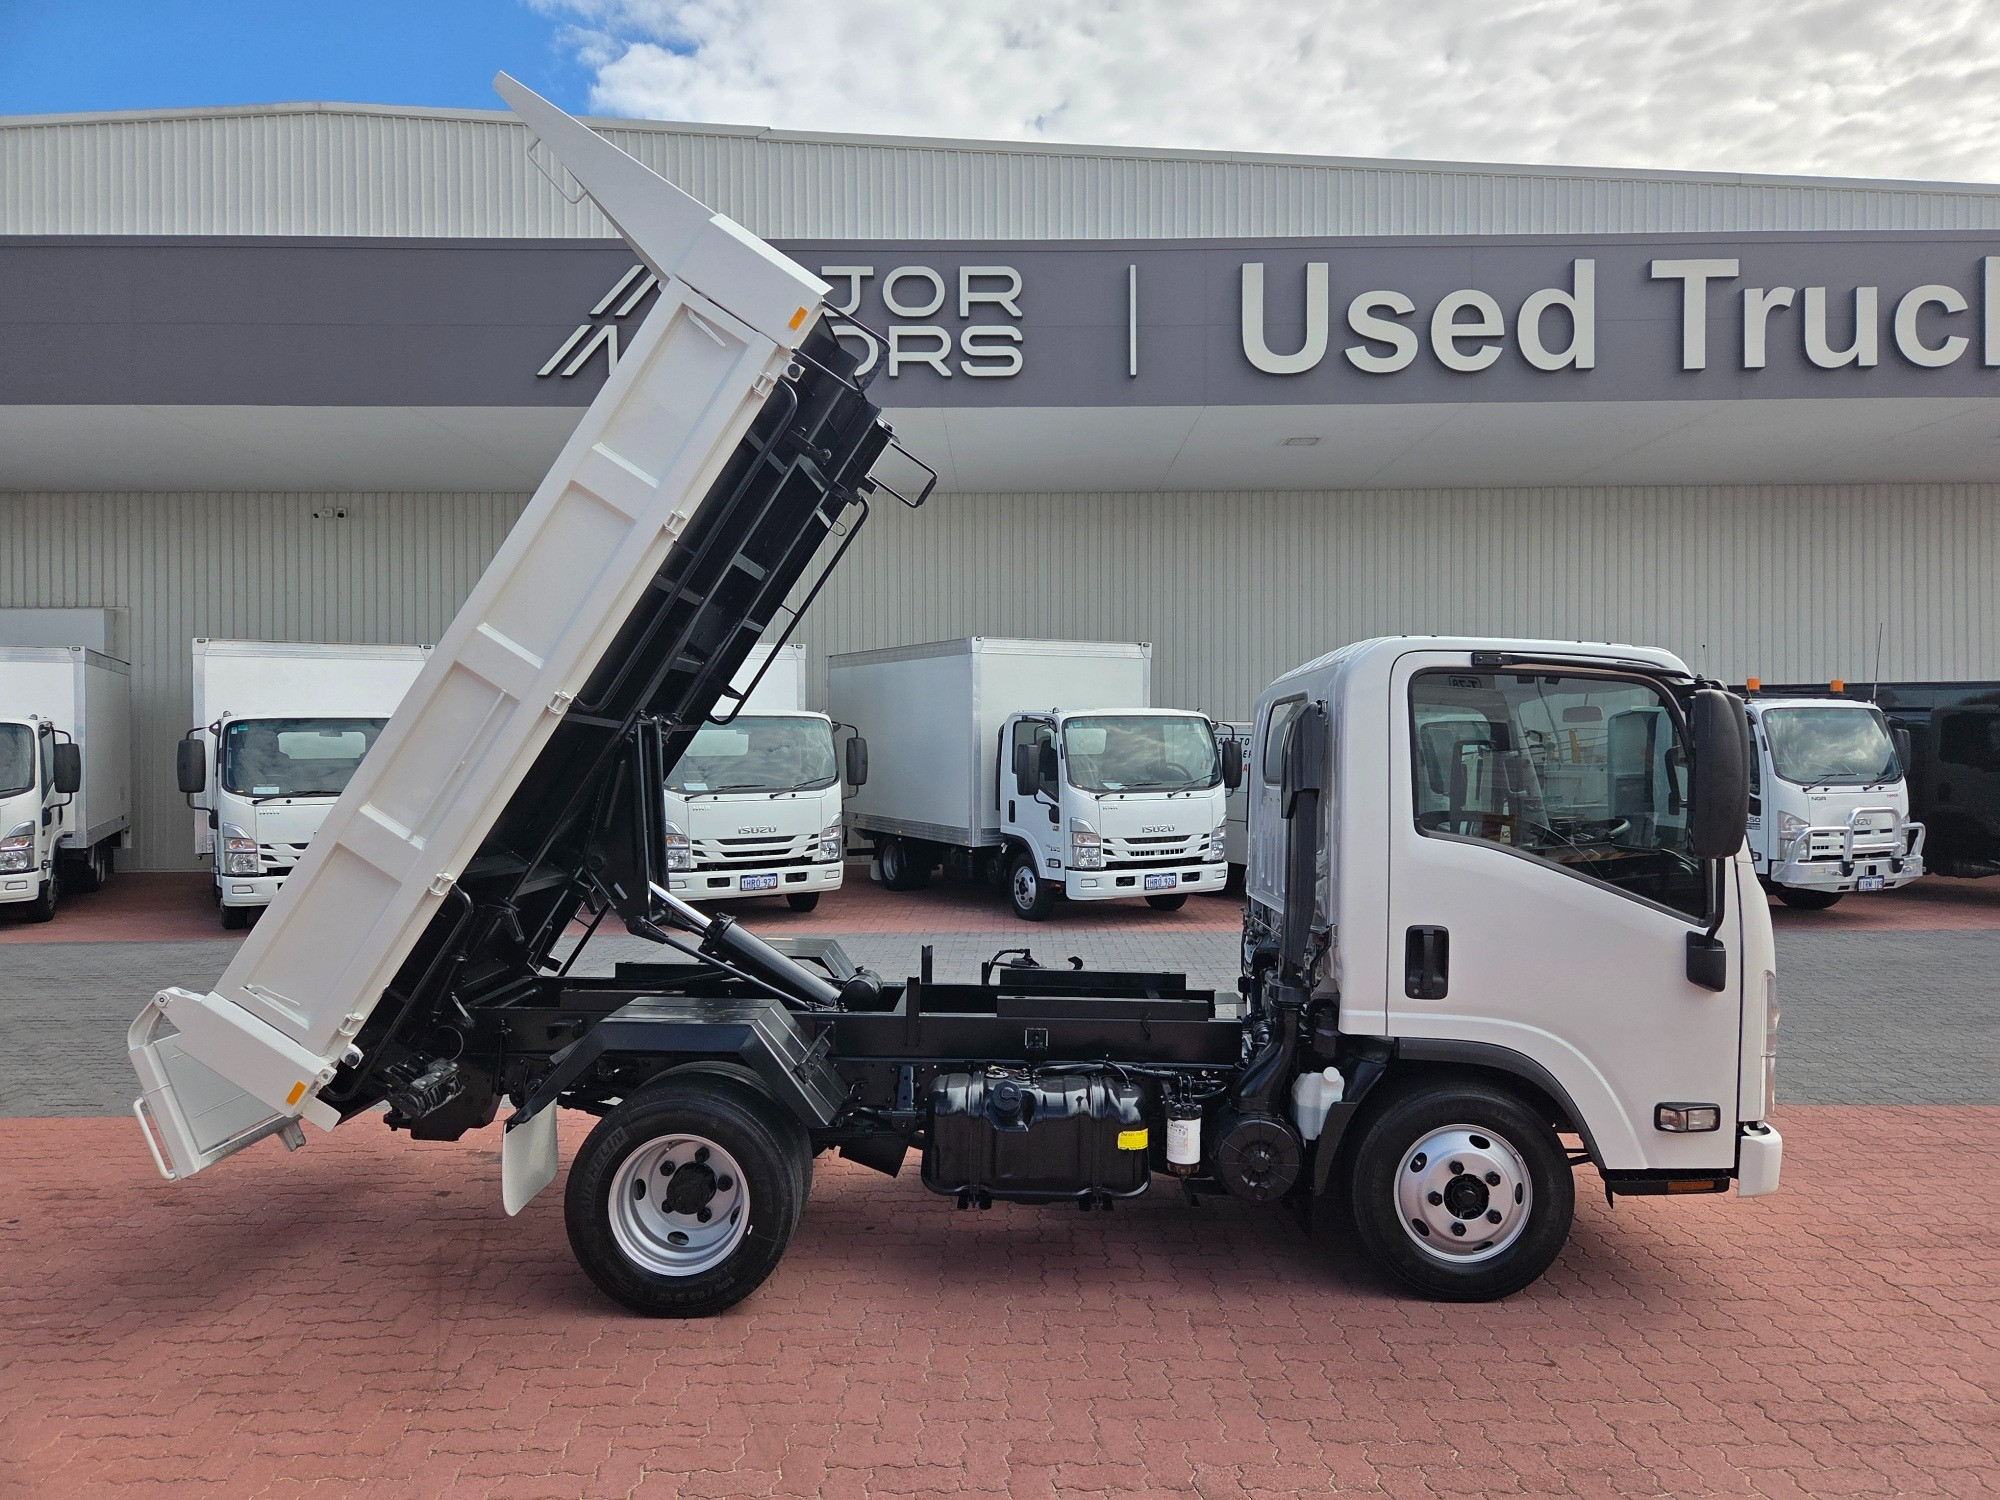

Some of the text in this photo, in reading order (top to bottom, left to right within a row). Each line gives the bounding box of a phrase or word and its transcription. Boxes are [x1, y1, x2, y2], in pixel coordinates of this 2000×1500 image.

[821, 265, 1023, 318] JOR
[1241, 258, 1595, 374] Used
[738, 825, 777, 834] ISUZU
[1142, 824, 1175, 833] ISUZU
